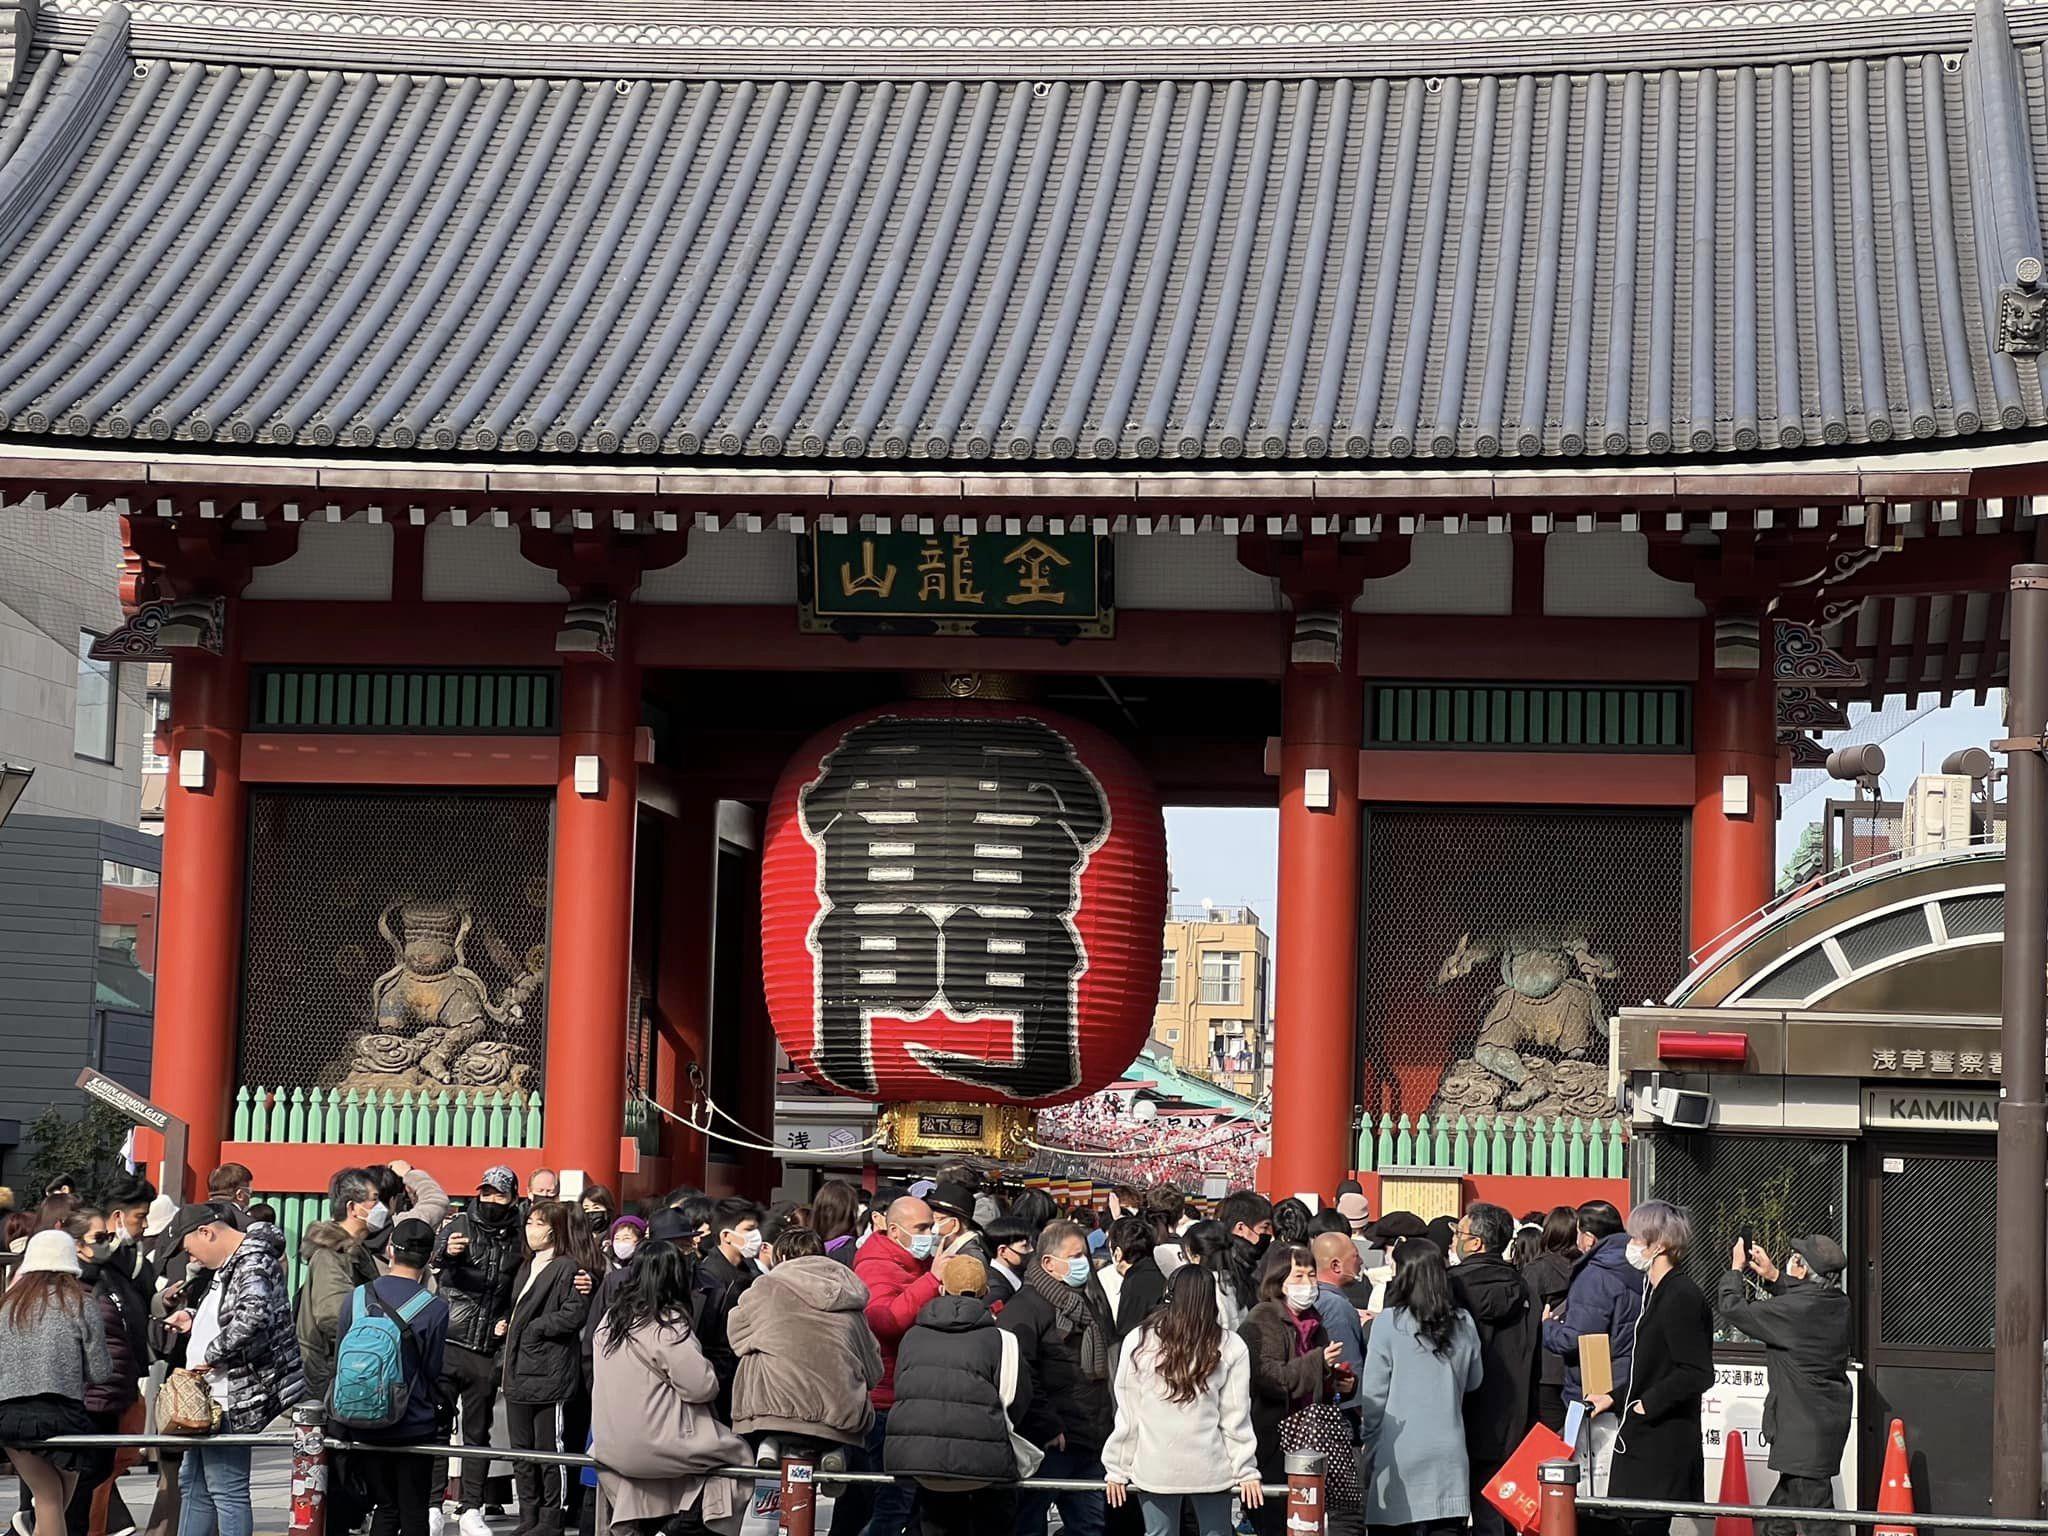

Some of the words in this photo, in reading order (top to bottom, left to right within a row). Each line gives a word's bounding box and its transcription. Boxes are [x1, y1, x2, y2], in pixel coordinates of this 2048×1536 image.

[797, 714, 1113, 1099] 雷門
[91, 1077, 147, 1112] KAMINARIMON
[144, 1107, 168, 1124] GATE
[921, 1117, 978, 1134] 松下電器
